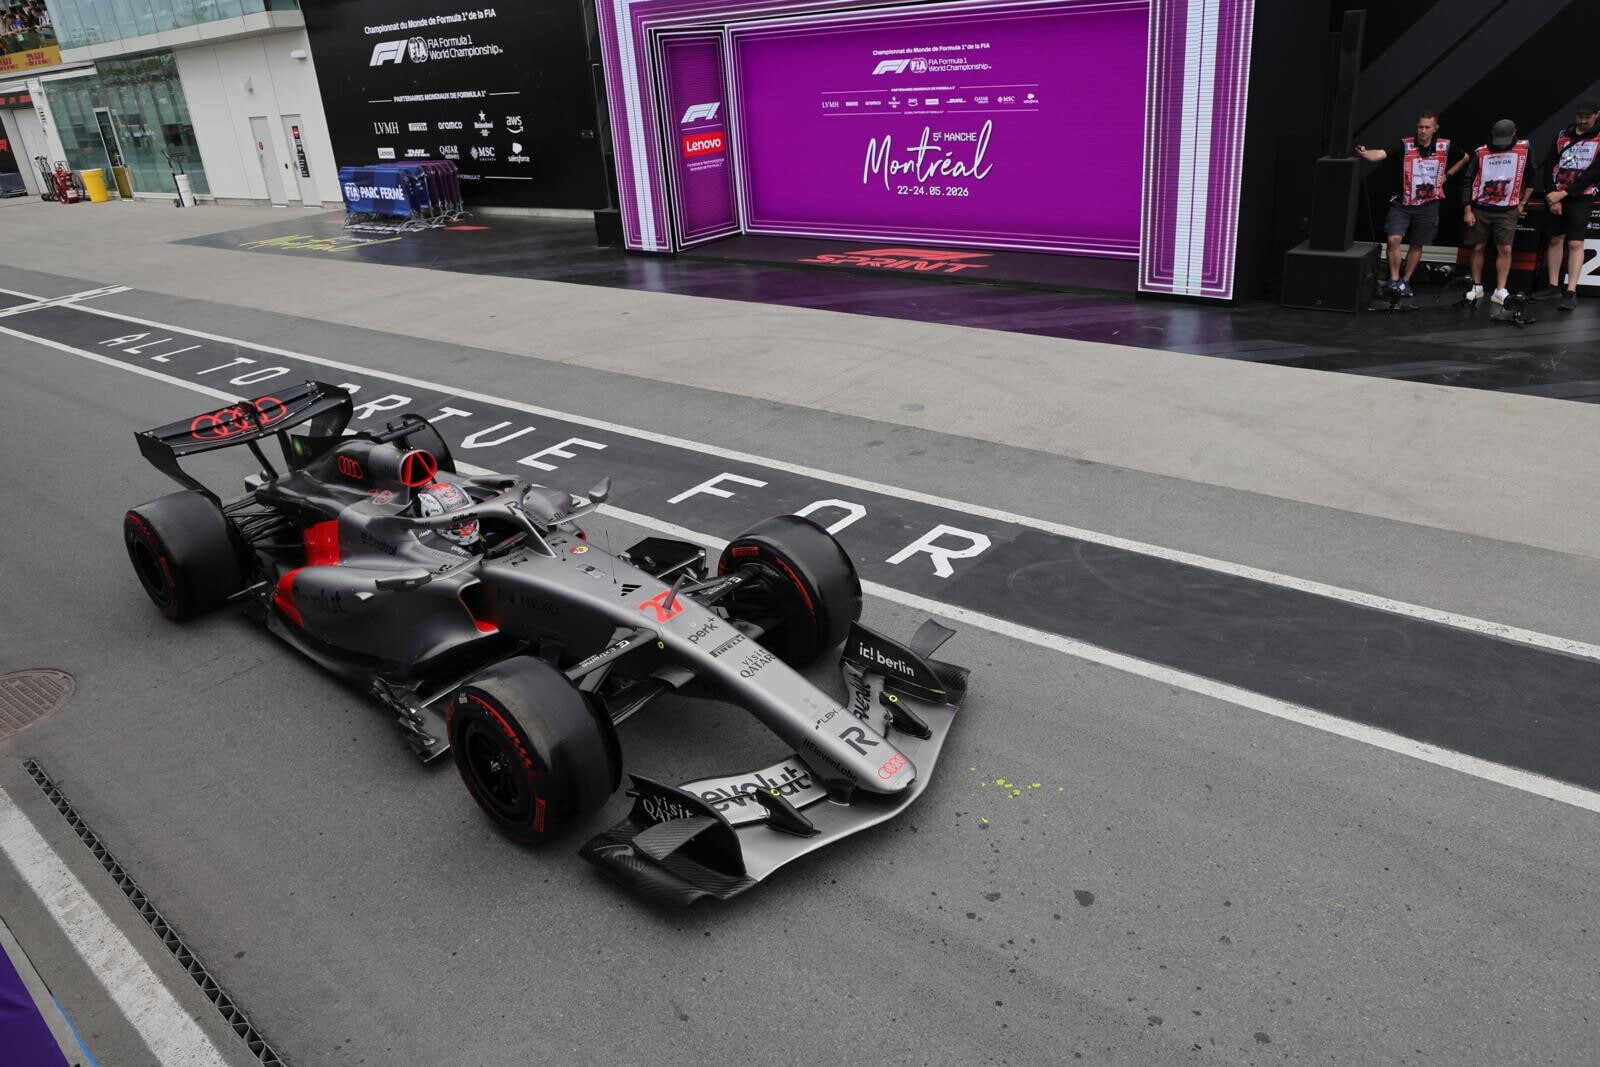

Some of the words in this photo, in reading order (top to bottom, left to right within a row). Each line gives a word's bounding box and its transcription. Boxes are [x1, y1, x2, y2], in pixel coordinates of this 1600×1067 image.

[365, 22, 400, 34] Championnat
[400, 22, 407, 30] du
[408, 18, 428, 29] Monde
[429, 17, 436, 25] de
[437, 13, 462, 24] Formula
[469, 11, 477, 20] de
[484, 8, 496, 18] FIA
[428, 39, 439, 49] FIA
[440, 36, 467, 48] Formula
[370, 39, 408, 66] F1
[430, 49, 449, 60] World
[872, 58, 910, 75] F1
[394, 95, 424, 103] PARTENAIRES
[457, 91, 481, 99] FORMULA
[506, 116, 523, 126] aws
[680, 102, 720, 124] F1
[374, 122, 400, 134] LVMH
[438, 122, 463, 130] aramco
[686, 138, 721, 152] Lenovo
[944, 132, 977, 141] MANCHE
[439, 146, 458, 155] QATAR
[478, 147, 495, 157] MSC
[863, 120, 993, 192] Montréal
[360, 186, 380, 199] PARC
[381, 185, 405, 200] FERMÉ
[897, 186, 969, 196] 22-24.05.2026
[798, 254, 990, 273] SPRINT
[98, 336, 202, 363] ALL
[196, 356, 291, 386] TO
[640, 590, 684, 624] 27
[708, 634, 746, 658] PIRELLI
[742, 648, 769, 666] visit
[860, 642, 874, 660] ic!
[877, 650, 914, 677] berlin
[740, 654, 776, 679] QATAR
[838, 726, 880, 756] R
